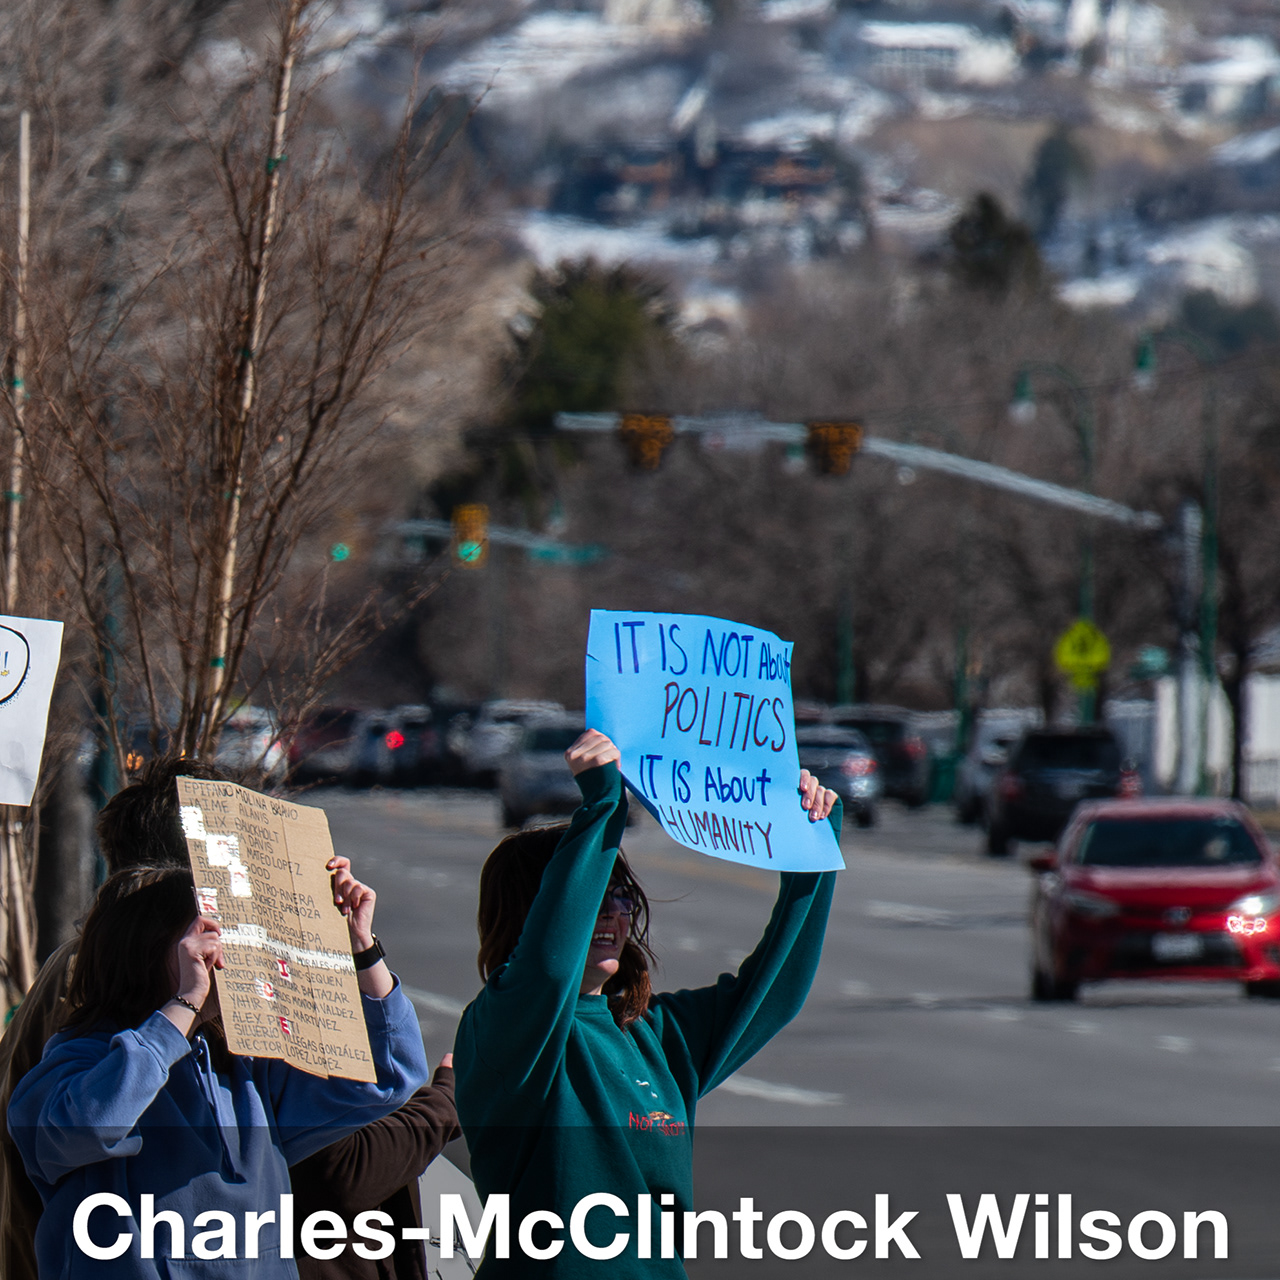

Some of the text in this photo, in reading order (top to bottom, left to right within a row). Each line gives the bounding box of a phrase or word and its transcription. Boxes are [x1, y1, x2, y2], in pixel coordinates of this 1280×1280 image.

[614, 621, 790, 687] IT IS NOT About
[661, 681, 786, 752] POLITICS
[639, 754, 771, 806] IT IS About
